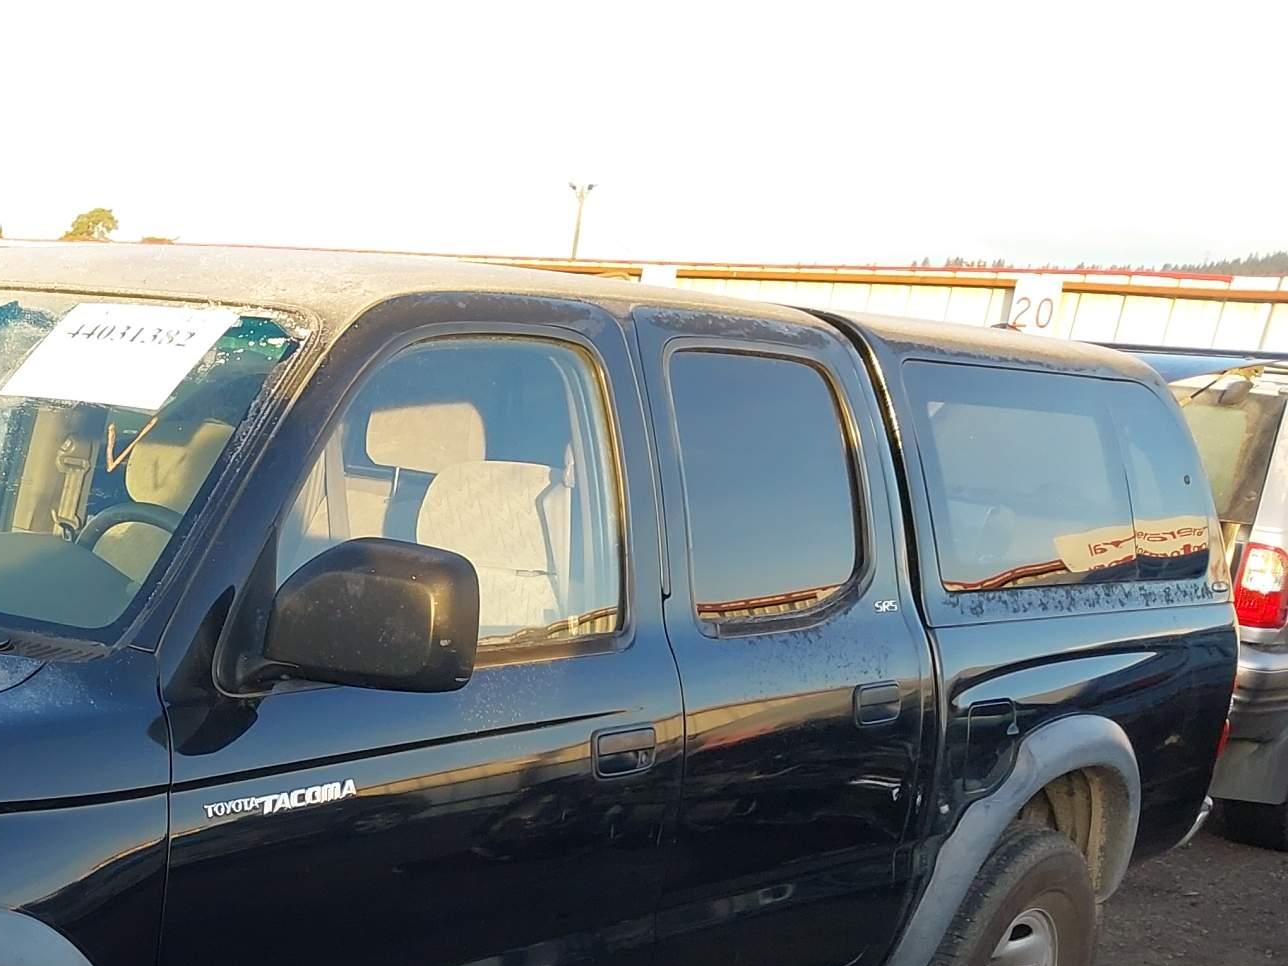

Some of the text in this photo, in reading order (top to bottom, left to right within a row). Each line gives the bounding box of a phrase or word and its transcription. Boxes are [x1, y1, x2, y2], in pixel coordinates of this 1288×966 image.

[1013, 296, 1054, 329] 20
[67, 323, 196, 347] 44031382
[203, 778, 357, 818] TOYOTA TACOMA
